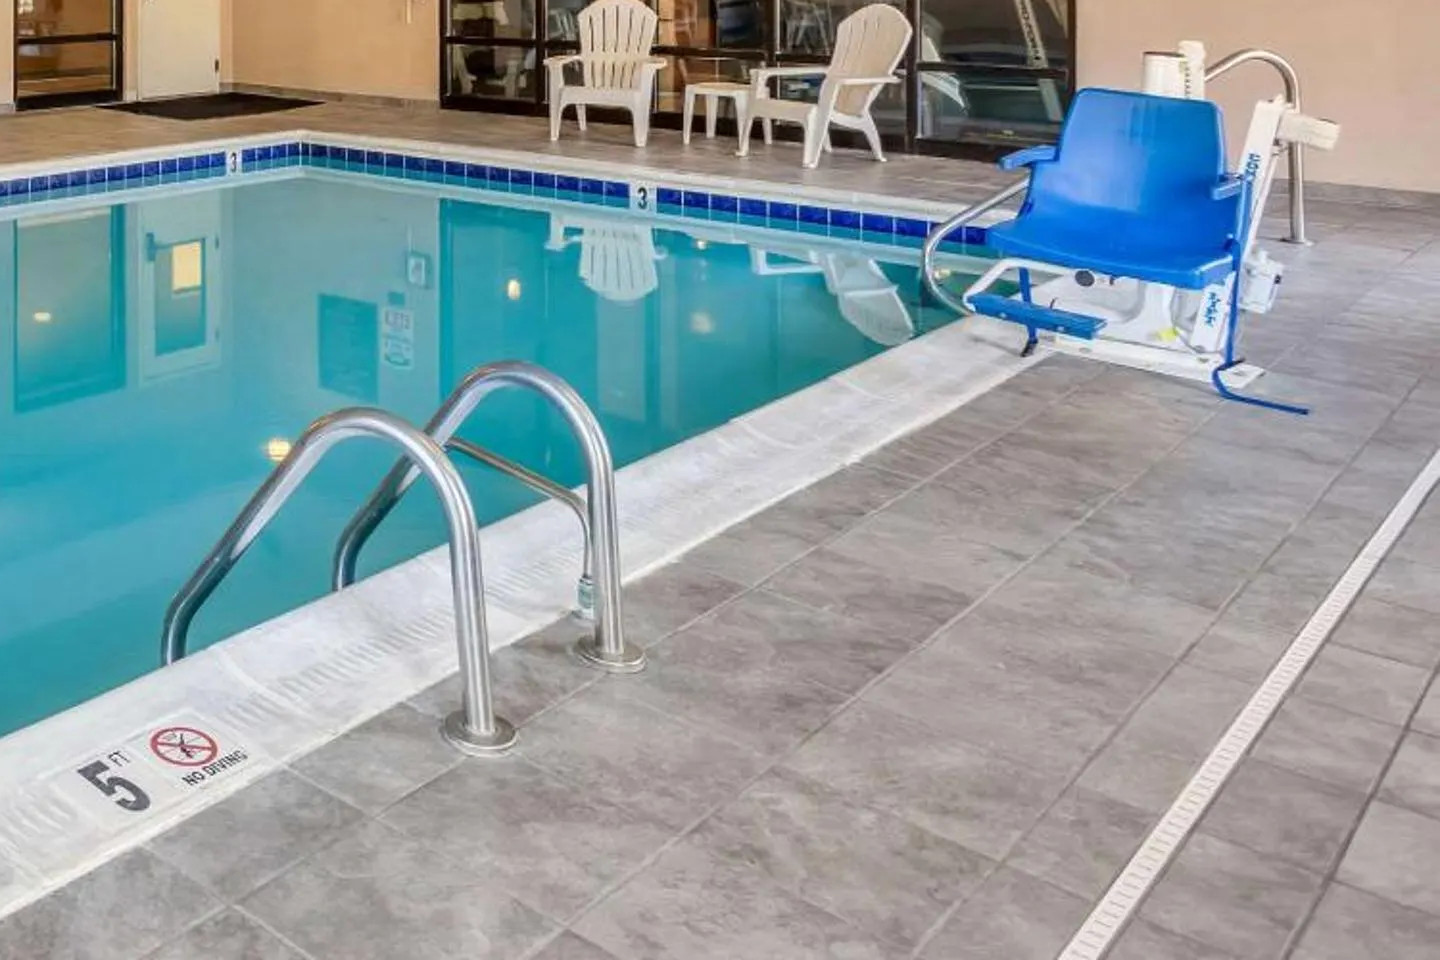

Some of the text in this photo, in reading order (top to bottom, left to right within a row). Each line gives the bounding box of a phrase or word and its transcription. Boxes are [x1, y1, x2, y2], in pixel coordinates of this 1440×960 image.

[638, 187, 647, 209] 3
[77, 750, 150, 811] 5 FT
[181, 749, 249, 786] NO DIVING
